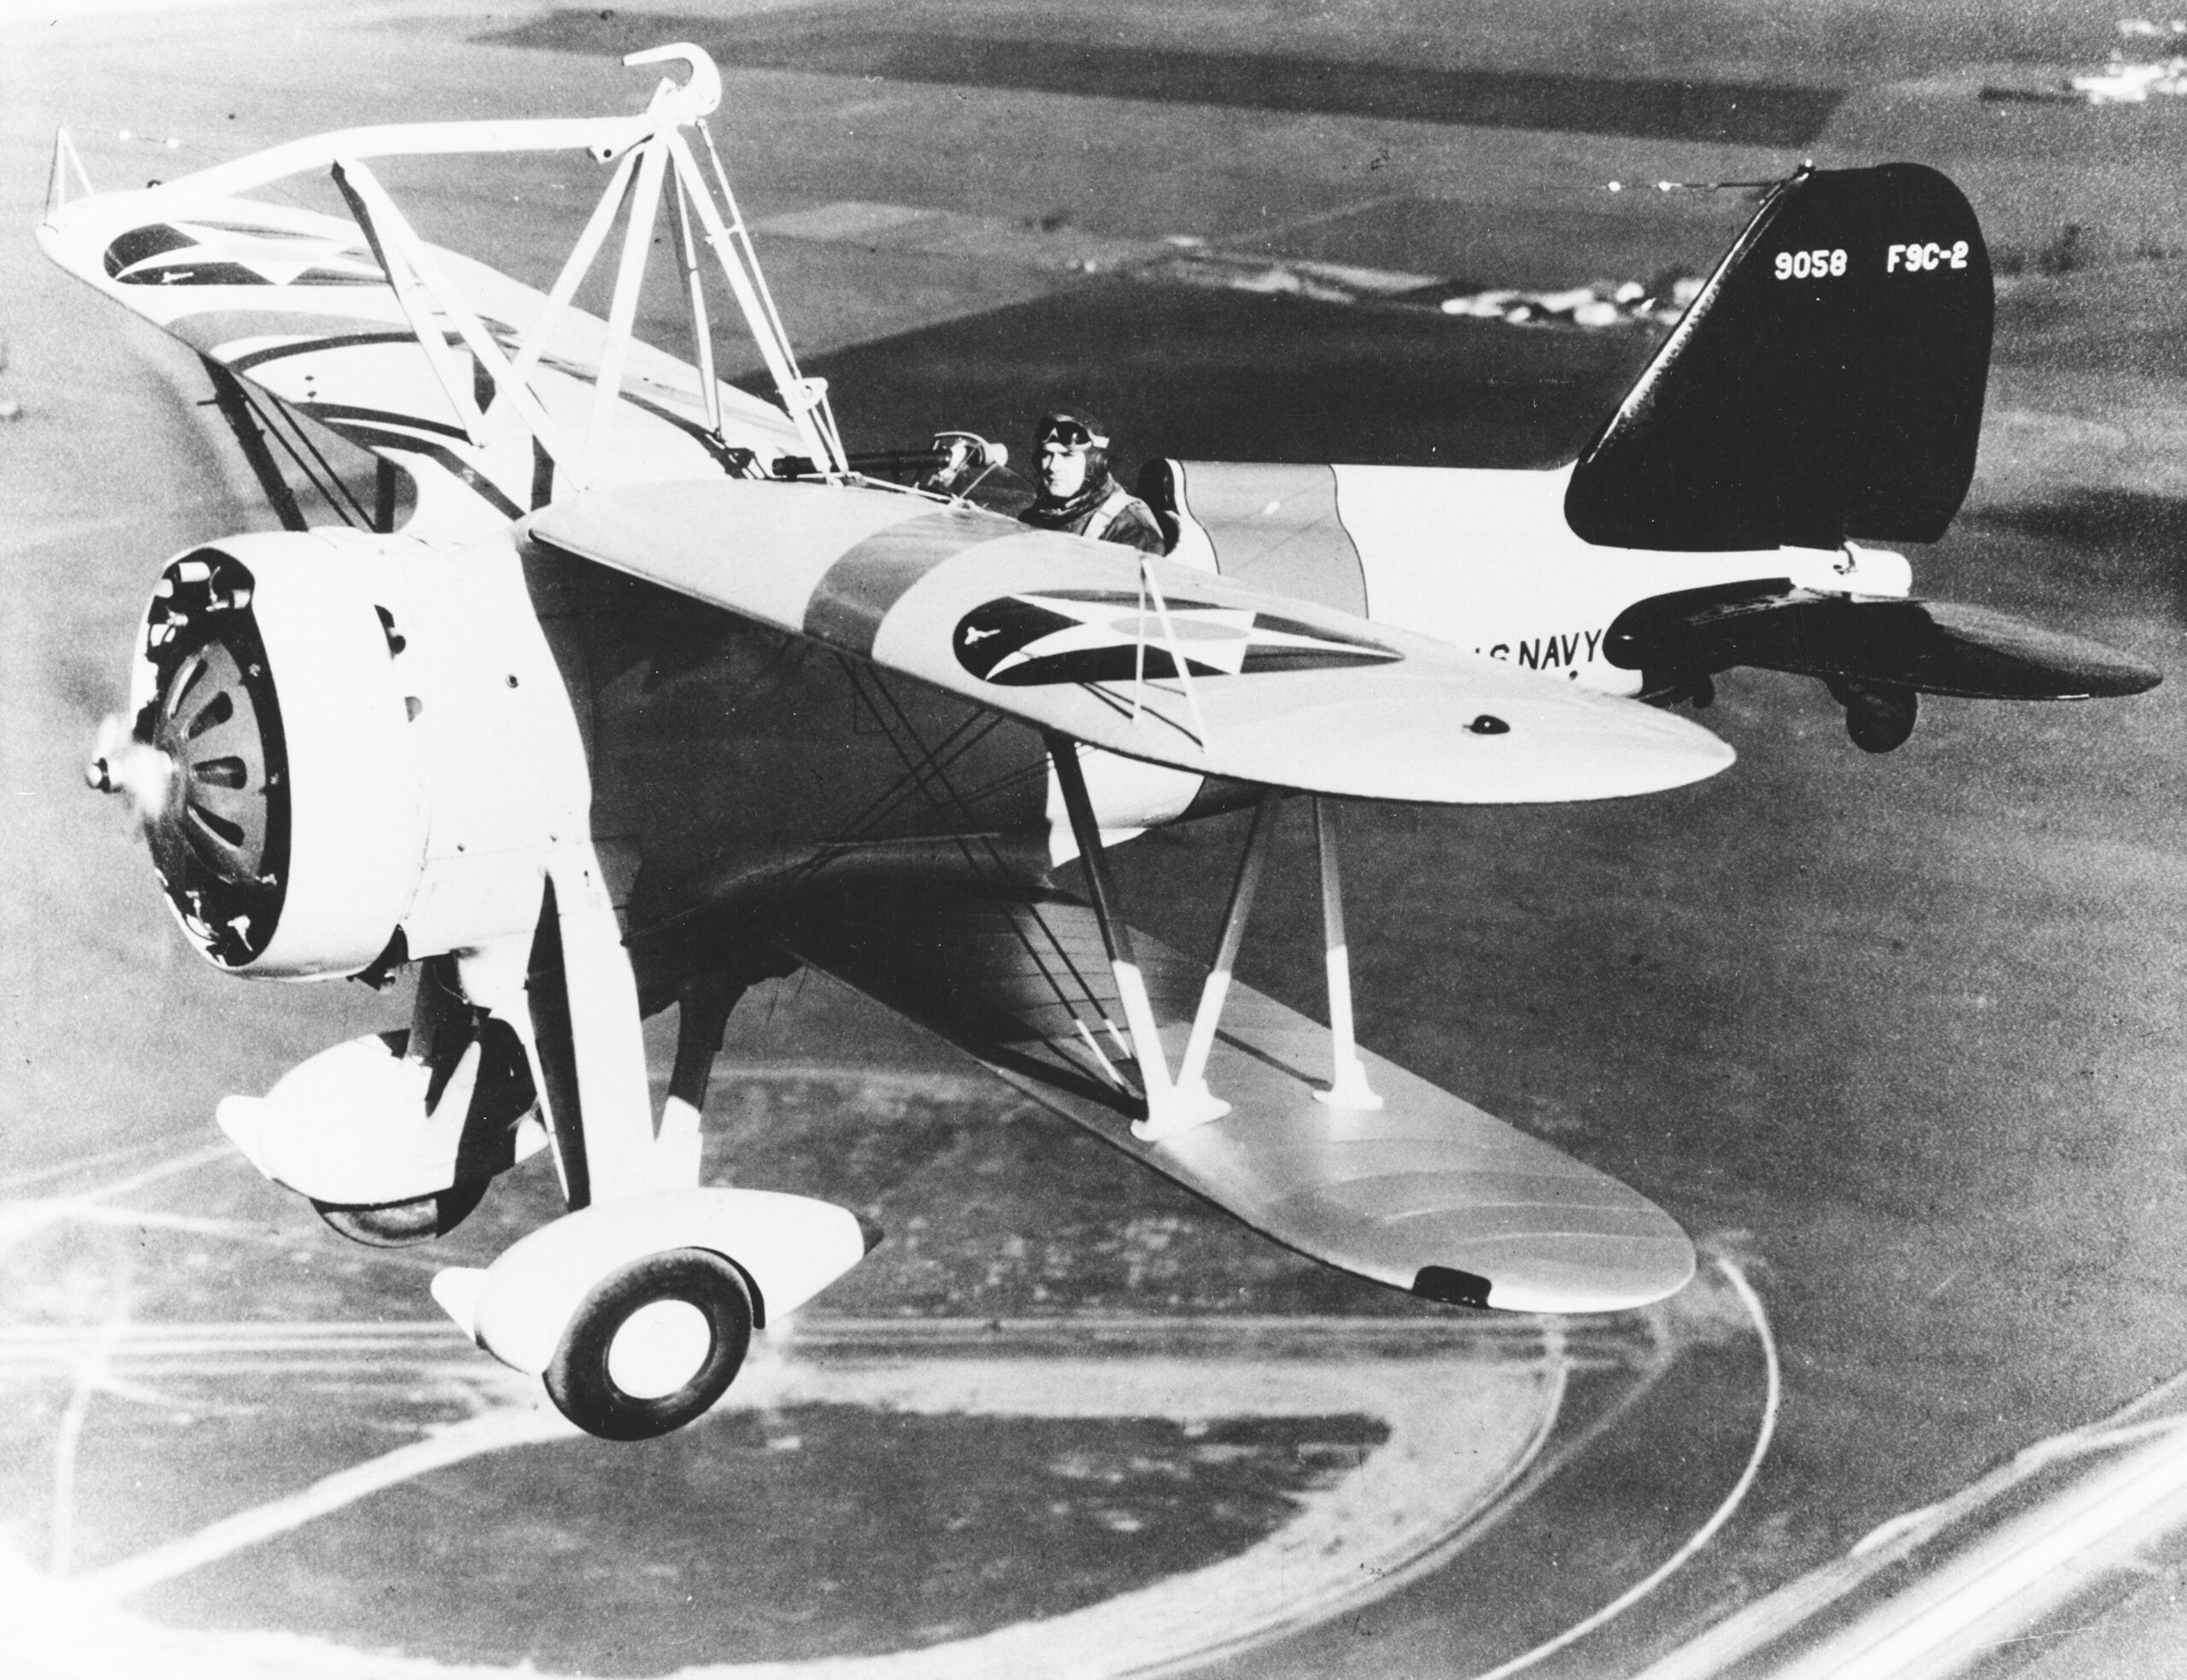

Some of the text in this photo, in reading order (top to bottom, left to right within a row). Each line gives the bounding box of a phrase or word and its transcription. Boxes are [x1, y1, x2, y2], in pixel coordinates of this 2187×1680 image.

[1774, 240, 1969, 280] 9058 F9C-2
[1518, 629, 1602, 670] NAVY
